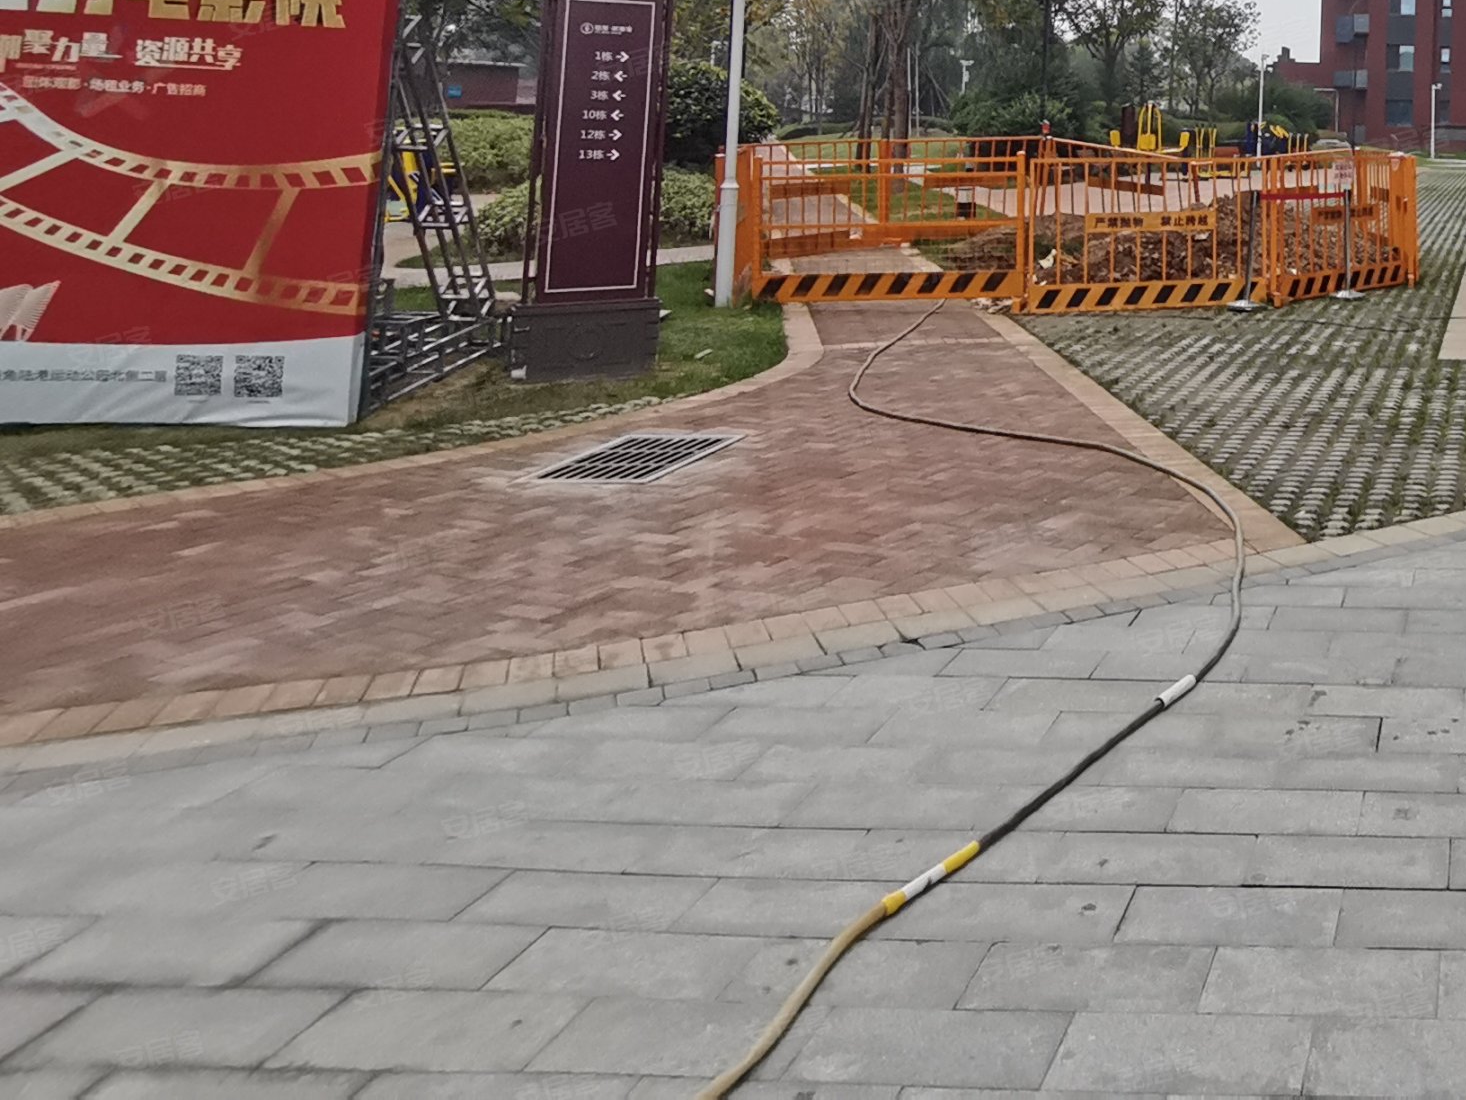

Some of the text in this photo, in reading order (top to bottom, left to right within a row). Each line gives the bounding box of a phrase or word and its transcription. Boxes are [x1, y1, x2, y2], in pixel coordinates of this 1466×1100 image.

[134, 36, 244, 70] 资源共享
[594, 51, 614, 62] 1栋
[591, 71, 611, 81] 2栋
[590, 90, 609, 100] 3栋
[582, 109, 608, 120] 10栋
[580, 129, 606, 140] 12栋
[578, 149, 605, 160] 13栋
